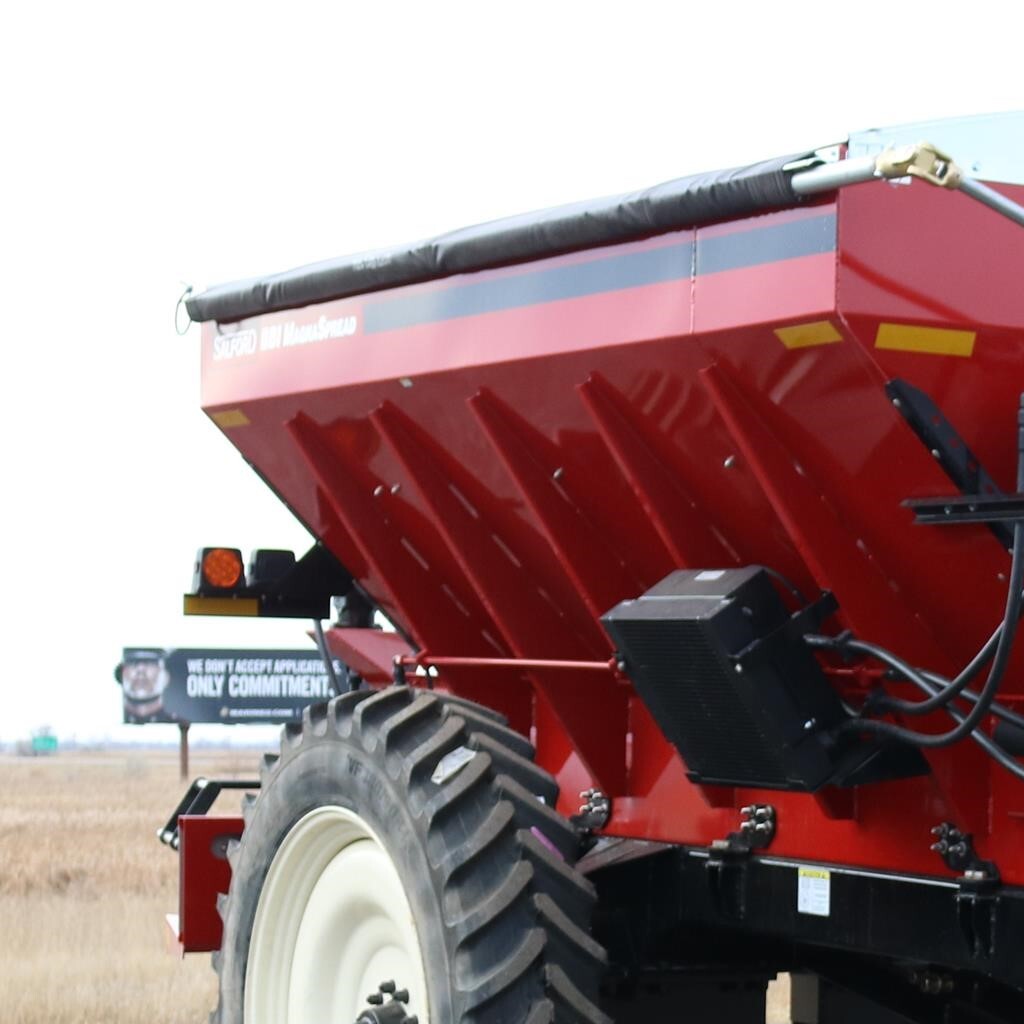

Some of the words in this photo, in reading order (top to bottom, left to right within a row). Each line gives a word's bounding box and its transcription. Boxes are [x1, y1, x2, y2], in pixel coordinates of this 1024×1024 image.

[212, 327, 257, 361] SALFORD
[187, 659, 204, 673] WE
[205, 659, 235, 673] DON'T
[235, 659, 273, 673] ACCEPT
[187, 674, 224, 698] ONLY
[228, 675, 335, 698] COMMITMENT.
